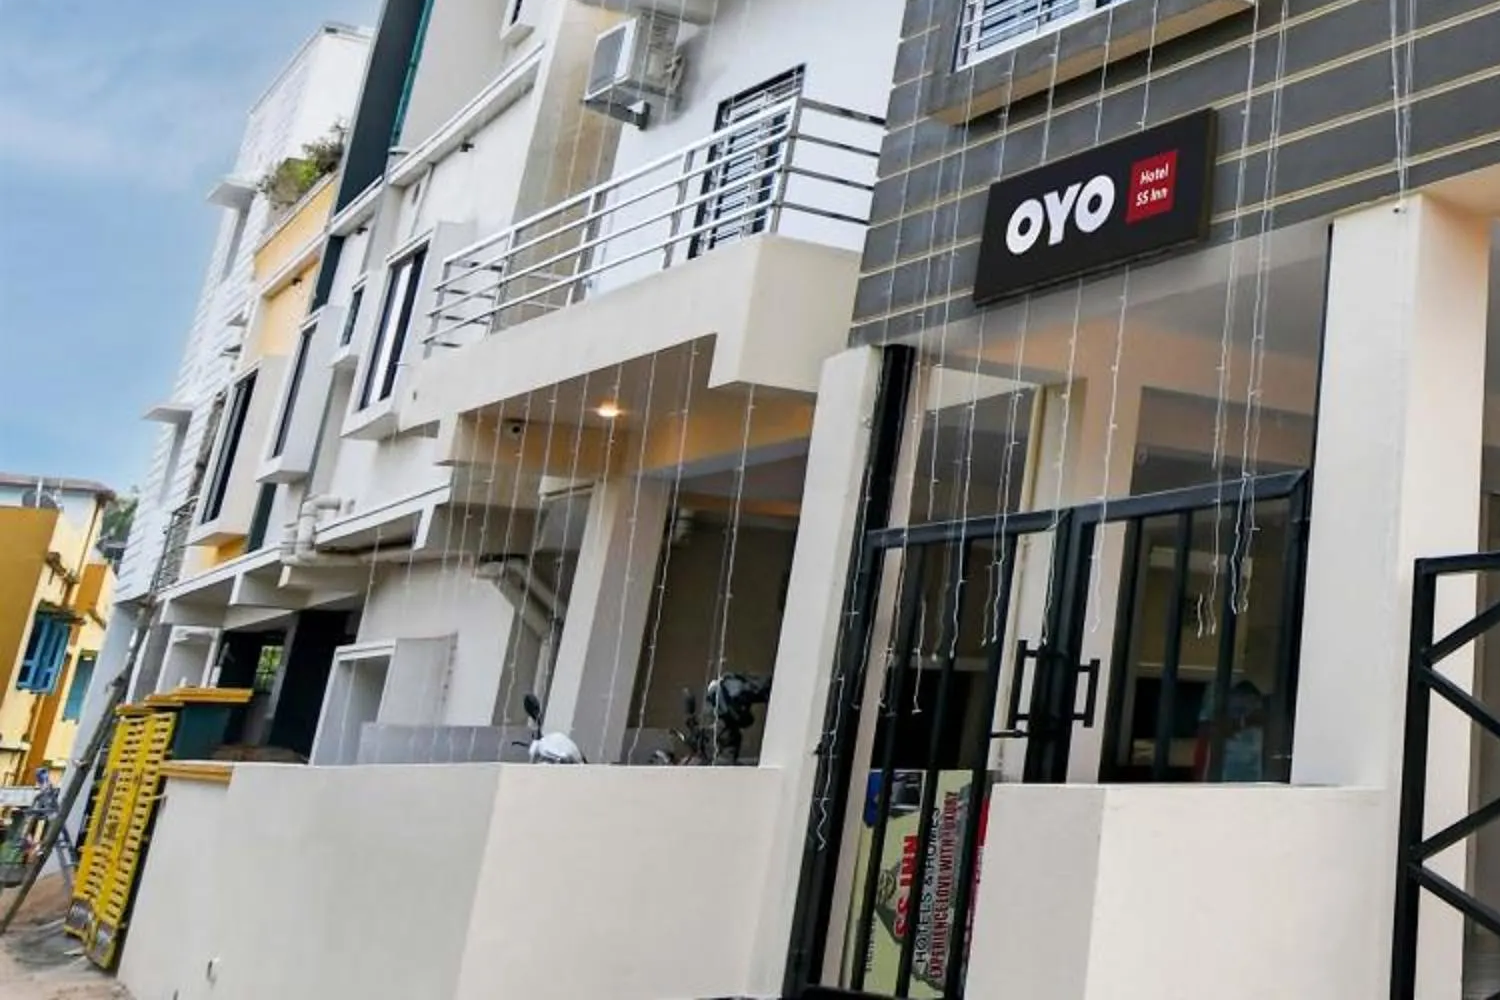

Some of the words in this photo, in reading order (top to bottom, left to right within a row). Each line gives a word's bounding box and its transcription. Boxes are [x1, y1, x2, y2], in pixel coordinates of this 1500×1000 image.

[1136, 190, 1149, 207] SS
[1150, 188, 1168, 202] Inn
[1140, 162, 1169, 185] Hotel
[1006, 175, 1115, 255] OYO
[915, 892, 932, 963] HOTELS
[928, 906, 949, 978] EXPERIENCE
